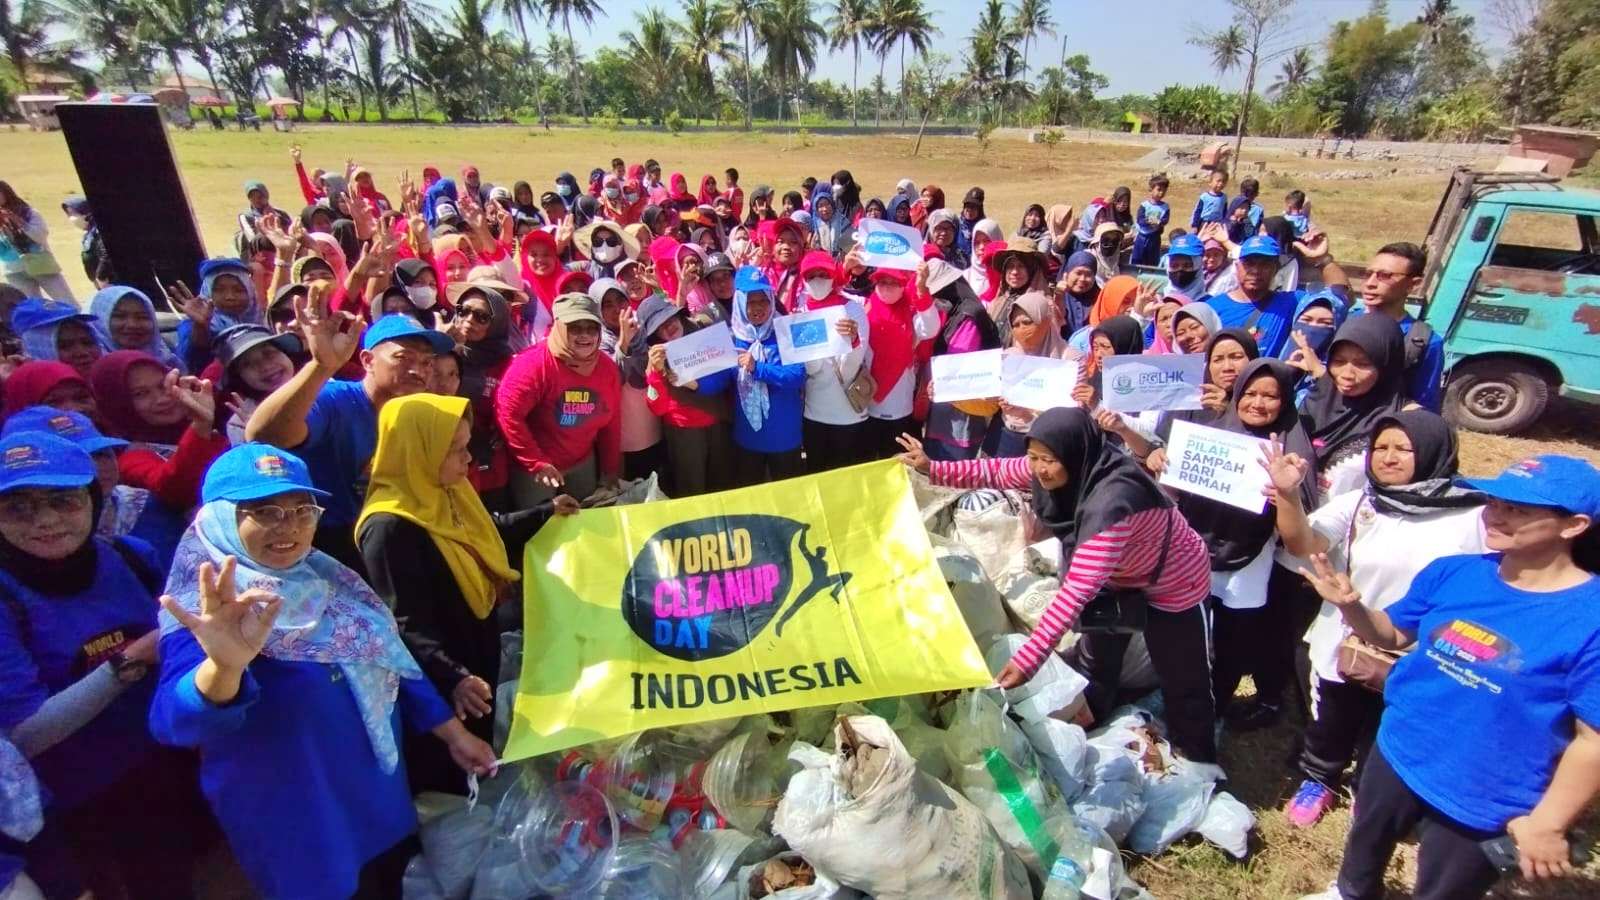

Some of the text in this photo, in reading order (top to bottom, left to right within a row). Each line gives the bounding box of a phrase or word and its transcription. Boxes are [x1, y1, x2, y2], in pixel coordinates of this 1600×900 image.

[1138, 370, 1184, 384] PGLHK
[565, 391, 590, 402] WORLD
[560, 414, 577, 425] DAY
[563, 403, 595, 415] CLEANUP
[1186, 440, 1230, 457] PILAH
[1181, 460, 1215, 478] DARI
[1183, 450, 1245, 474] SAMPAH
[1179, 471, 1231, 493] RUMAH
[652, 528, 752, 578] WORLD
[654, 563, 780, 619] CLEANUP
[655, 614, 713, 649] DAY
[1451, 619, 1498, 646] WORLD
[83, 630, 125, 657] WORLD
[1434, 638, 1458, 657] DAY
[630, 657, 862, 710] INDONESIA
